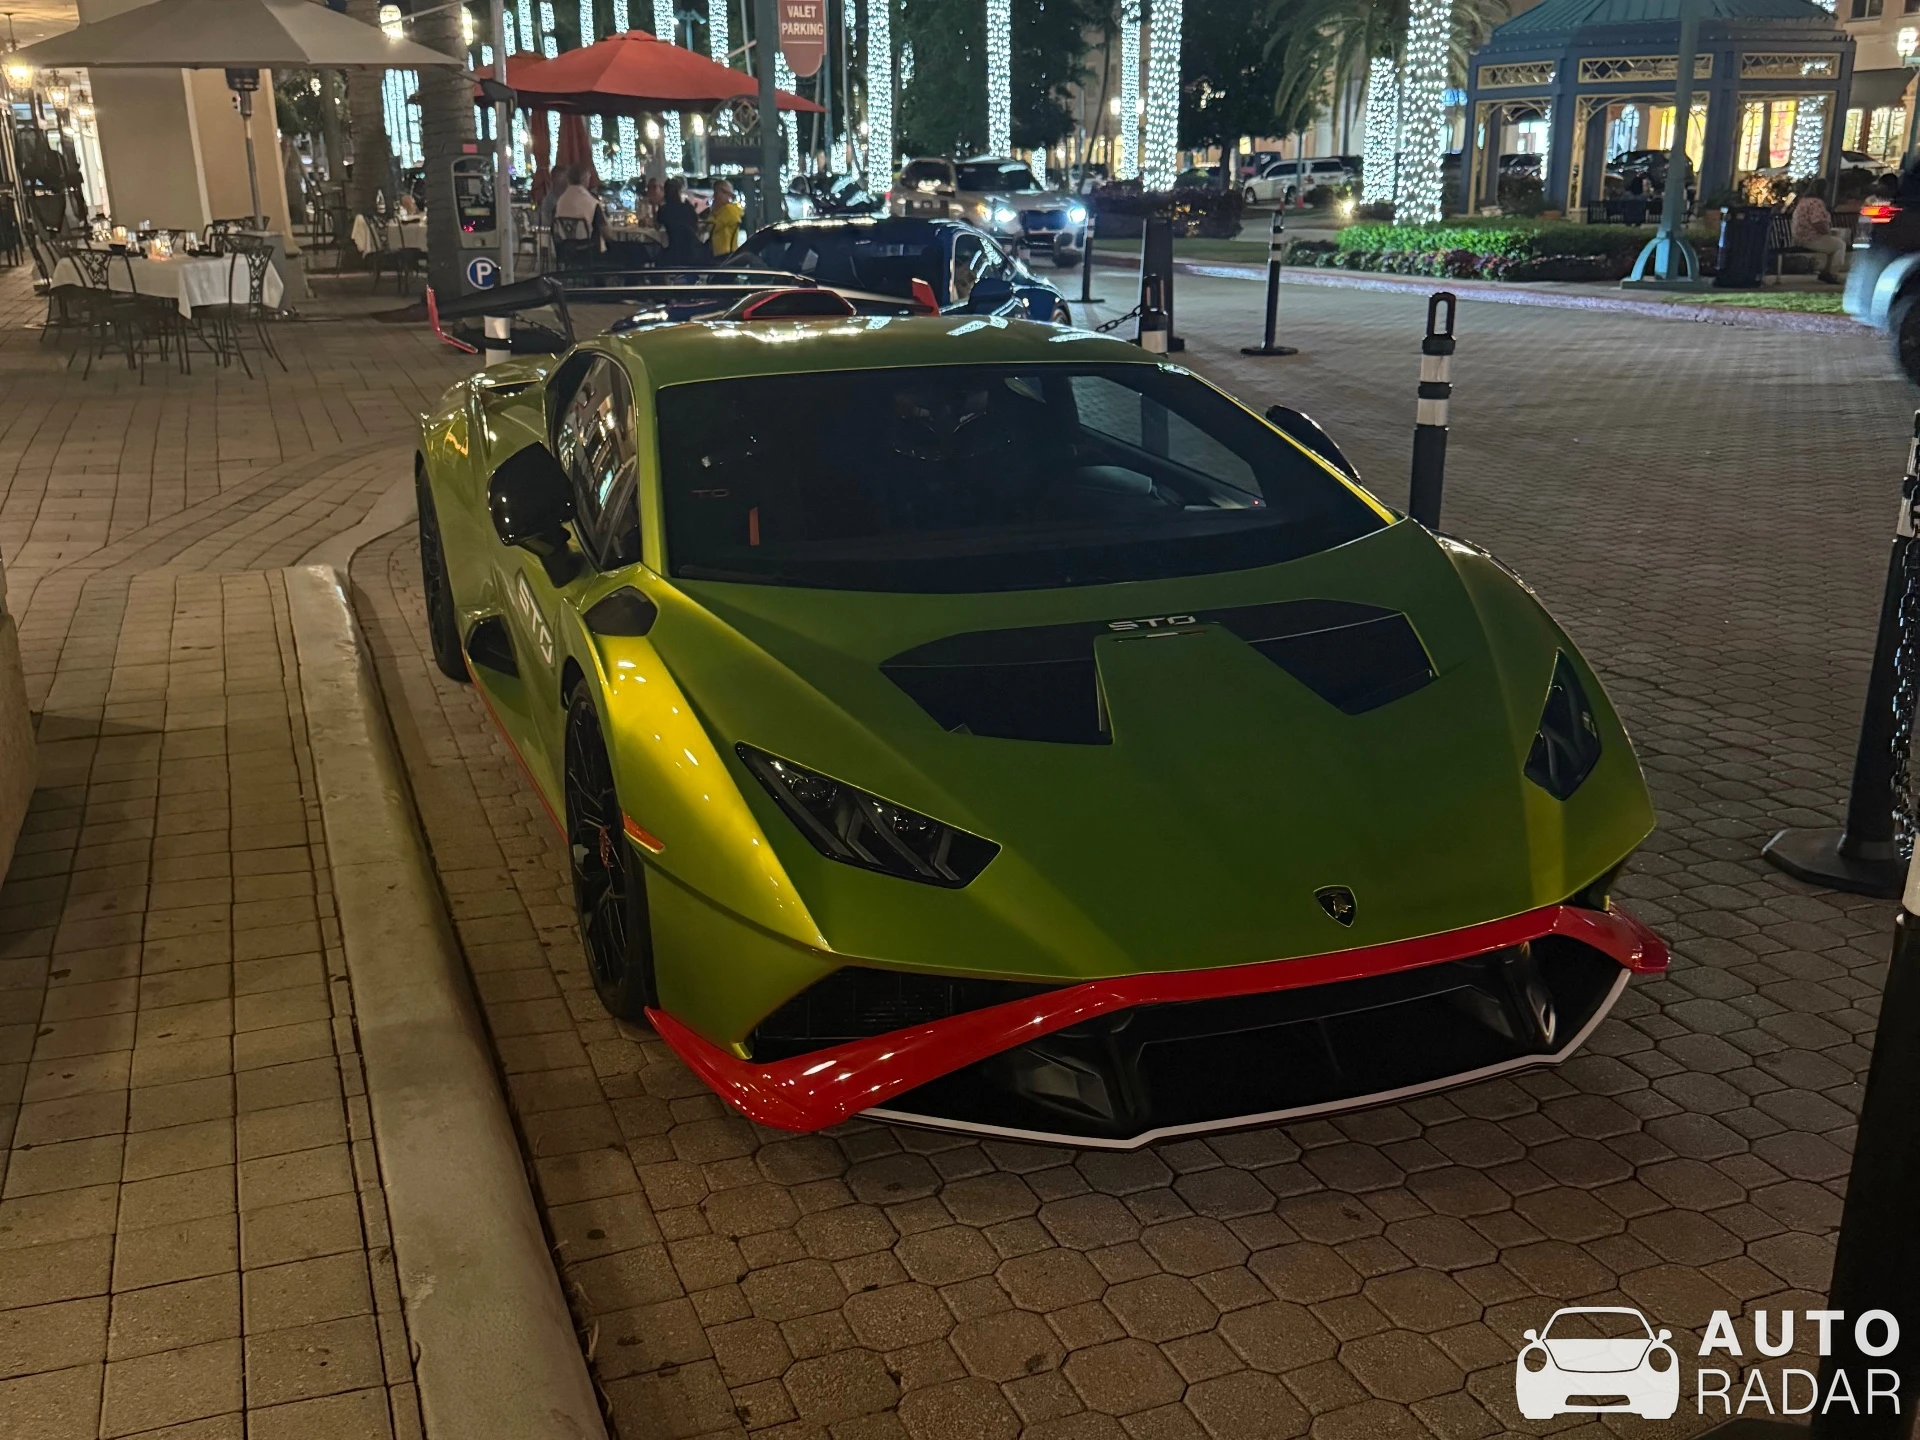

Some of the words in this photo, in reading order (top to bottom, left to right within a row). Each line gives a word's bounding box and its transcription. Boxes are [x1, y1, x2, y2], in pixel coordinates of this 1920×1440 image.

[787, 5, 817, 18] VALET
[781, 22, 824, 35] PARKING
[476, 262, 492, 285] P
[519, 578, 553, 665] STO
[1108, 615, 1196, 631] STO
